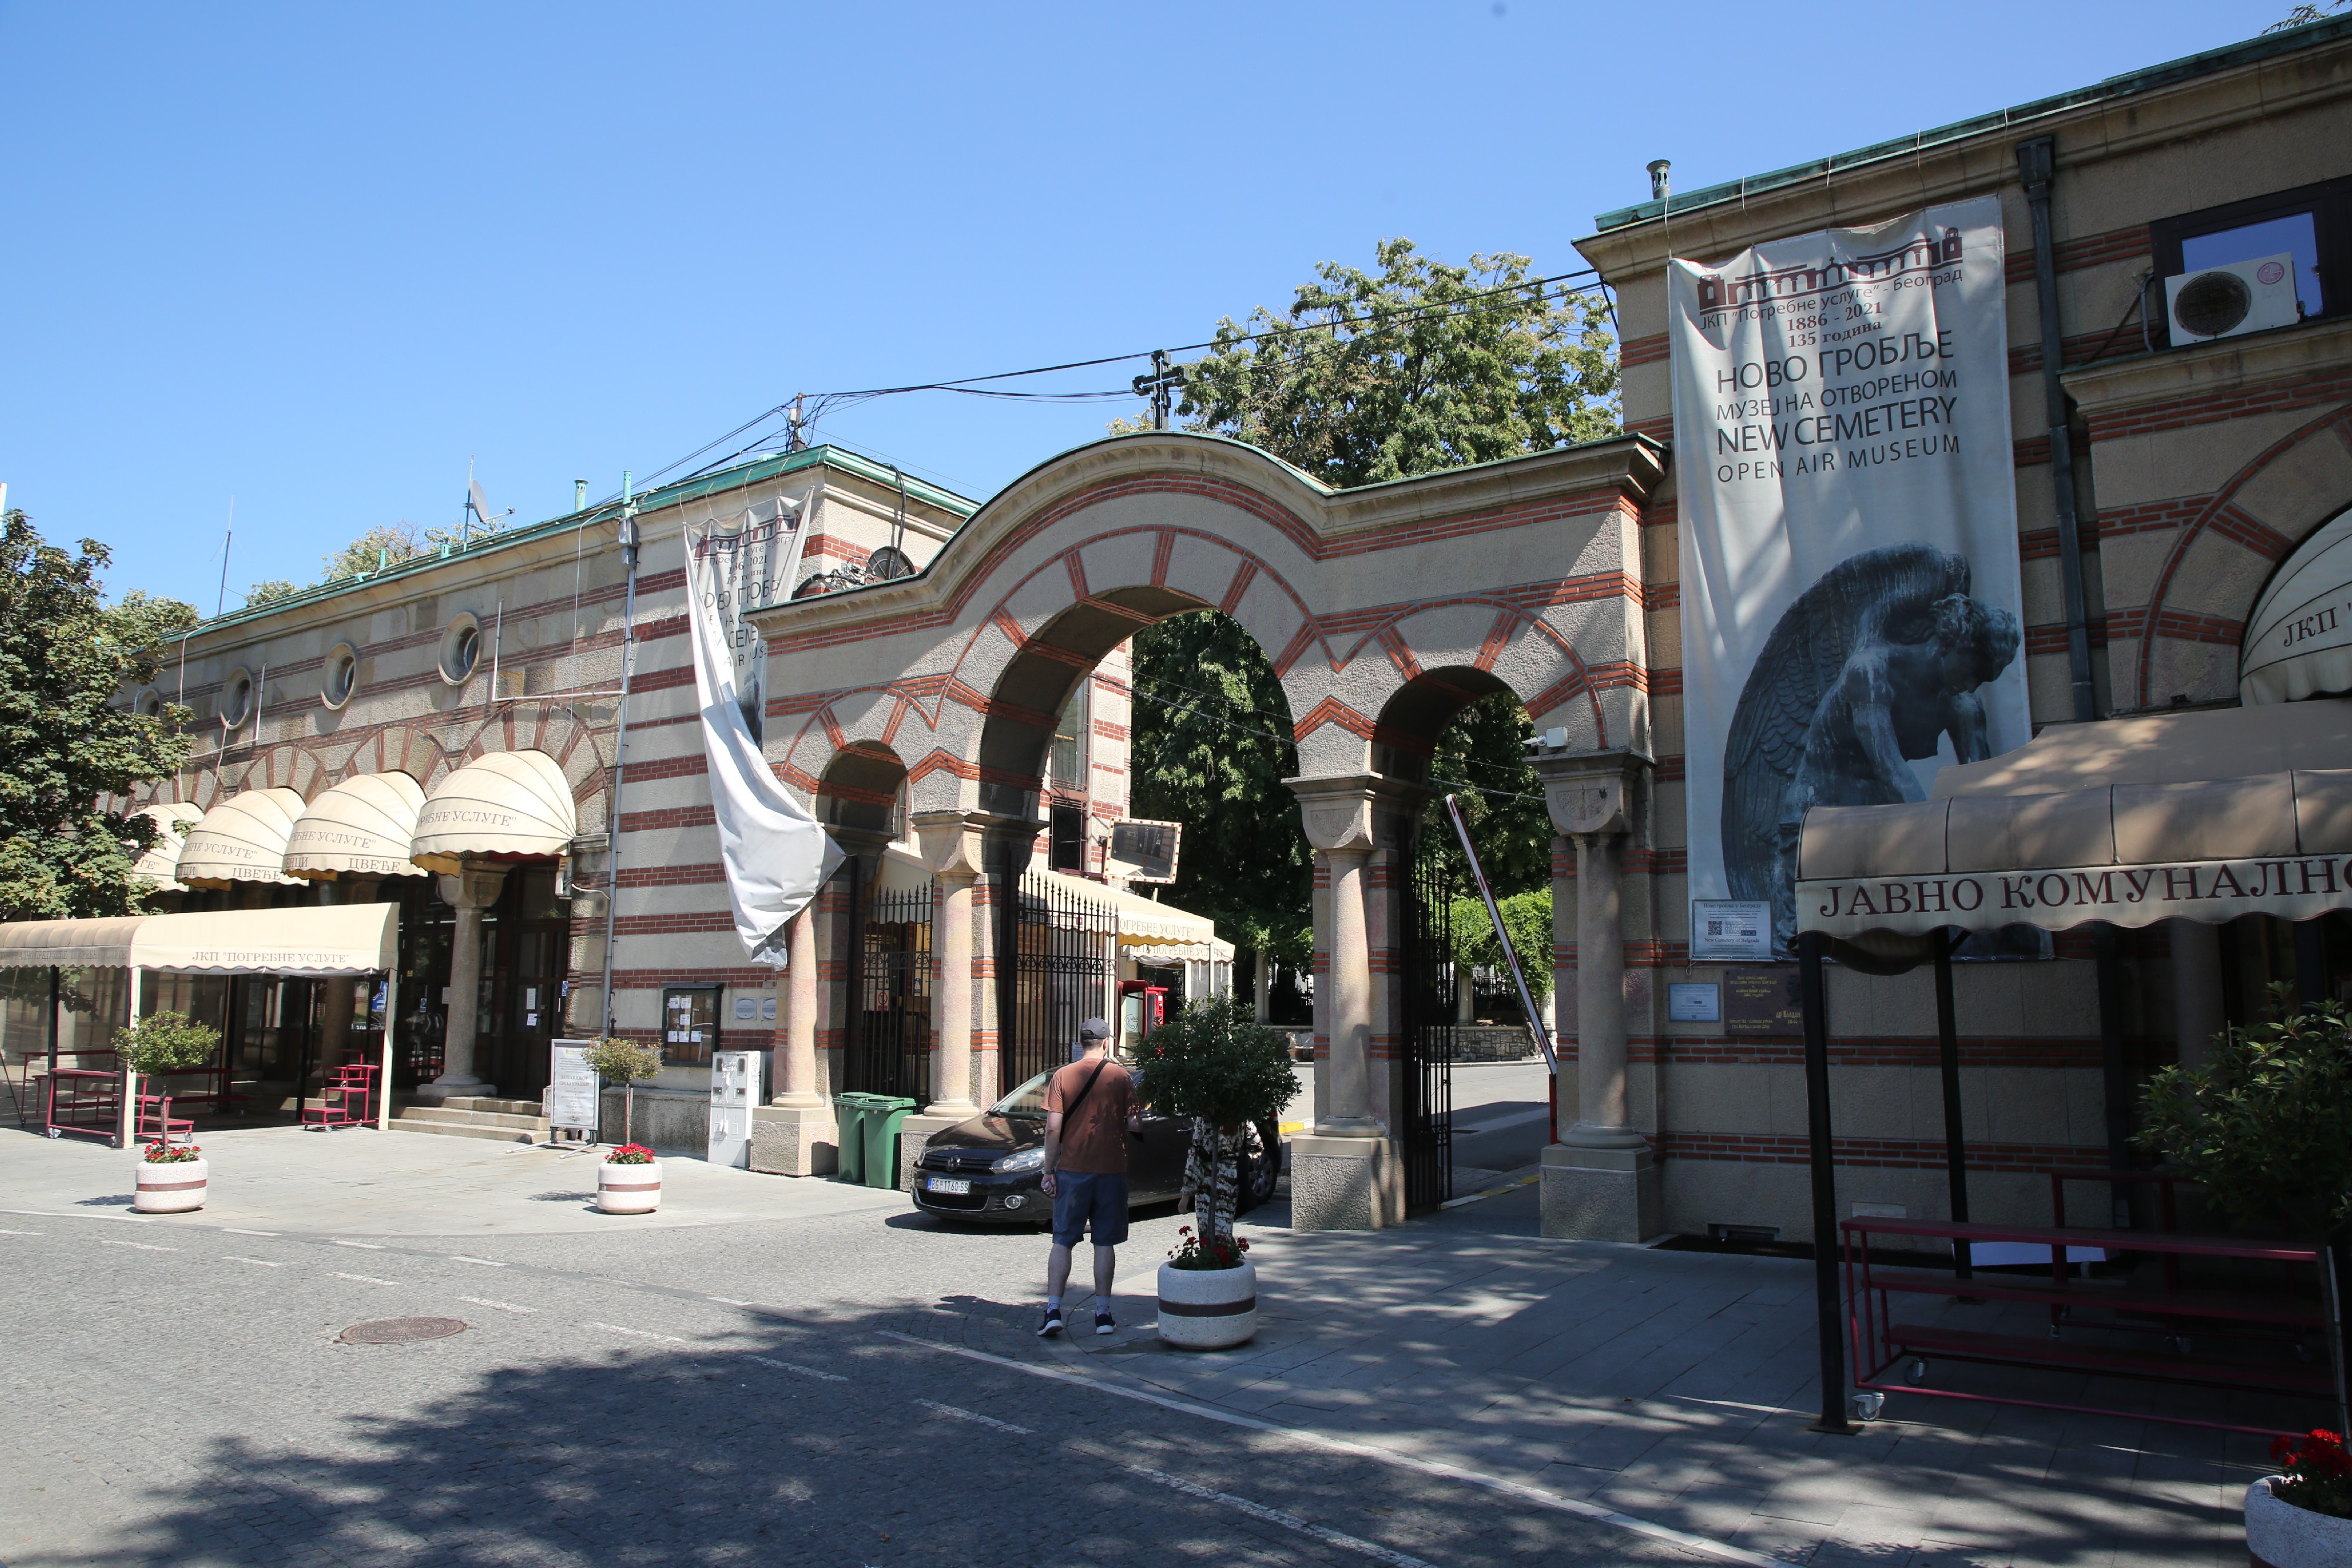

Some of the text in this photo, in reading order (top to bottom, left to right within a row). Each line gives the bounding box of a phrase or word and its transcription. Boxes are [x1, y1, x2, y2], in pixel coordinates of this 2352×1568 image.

[1700, 312, 1728, 330] ЈКП
[1893, 268, 1963, 292] Београд
[1787, 313, 1828, 332] 1886
[1845, 302, 1883, 322] 2021
[1789, 320, 1883, 348] 135 година
[1717, 330, 1955, 393] НОВО ГРОБЉЕ
[1716, 369, 1957, 421] МУЗЕЈ НА ОТВОРЕНОМ
[1717, 396, 1957, 456] NEW CEMETERY
[1717, 434, 1960, 483] OPEN AIR MUSEUM
[2283, 606, 2338, 647] ЈКП
[452, 811, 517, 827] УСЛУГЕ"
[205, 843, 258, 859] УСЛУГЕ"
[317, 831, 376, 848] УСЛУГЕ"
[232, 867, 282, 881] ЦВЕЋЕ
[348, 858, 400, 872] ЦВЕЋЕ
[1819, 878, 1984, 918] ЈАВНО
[1160, 924, 1195, 938] УСЛУГЕ"
[192, 951, 349, 964] ЈКП "ПОГРЕБНЕ УСЛУГЕ"
[932, 1179, 939, 1189] BG
